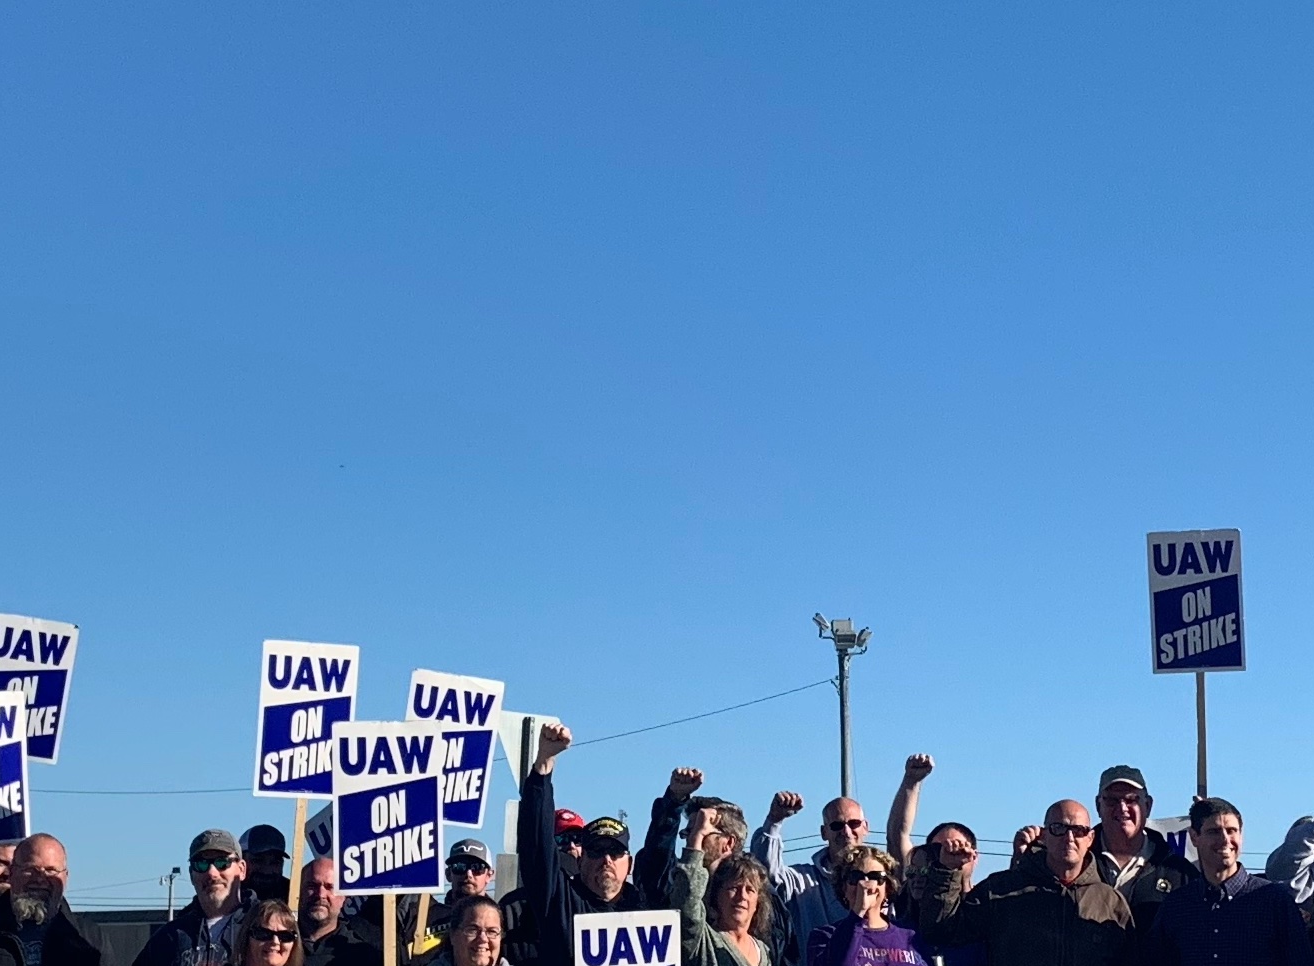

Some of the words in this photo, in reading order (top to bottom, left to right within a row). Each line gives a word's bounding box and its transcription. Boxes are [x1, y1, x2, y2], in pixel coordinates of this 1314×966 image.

[1152, 541, 1233, 576] UAW
[1181, 588, 1211, 622] ON
[1160, 615, 1237, 663] STRIKE
[268, 655, 352, 692] UAW
[413, 683, 496, 726] UAW
[290, 705, 323, 744] ON
[263, 739, 333, 786] STRIK
[339, 736, 436, 775] UAW
[442, 737, 464, 769] N
[442, 768, 483, 804] IKE
[371, 790, 407, 833] ON
[343, 828, 436, 884] STRIKE
[581, 925, 672, 966] UAW
